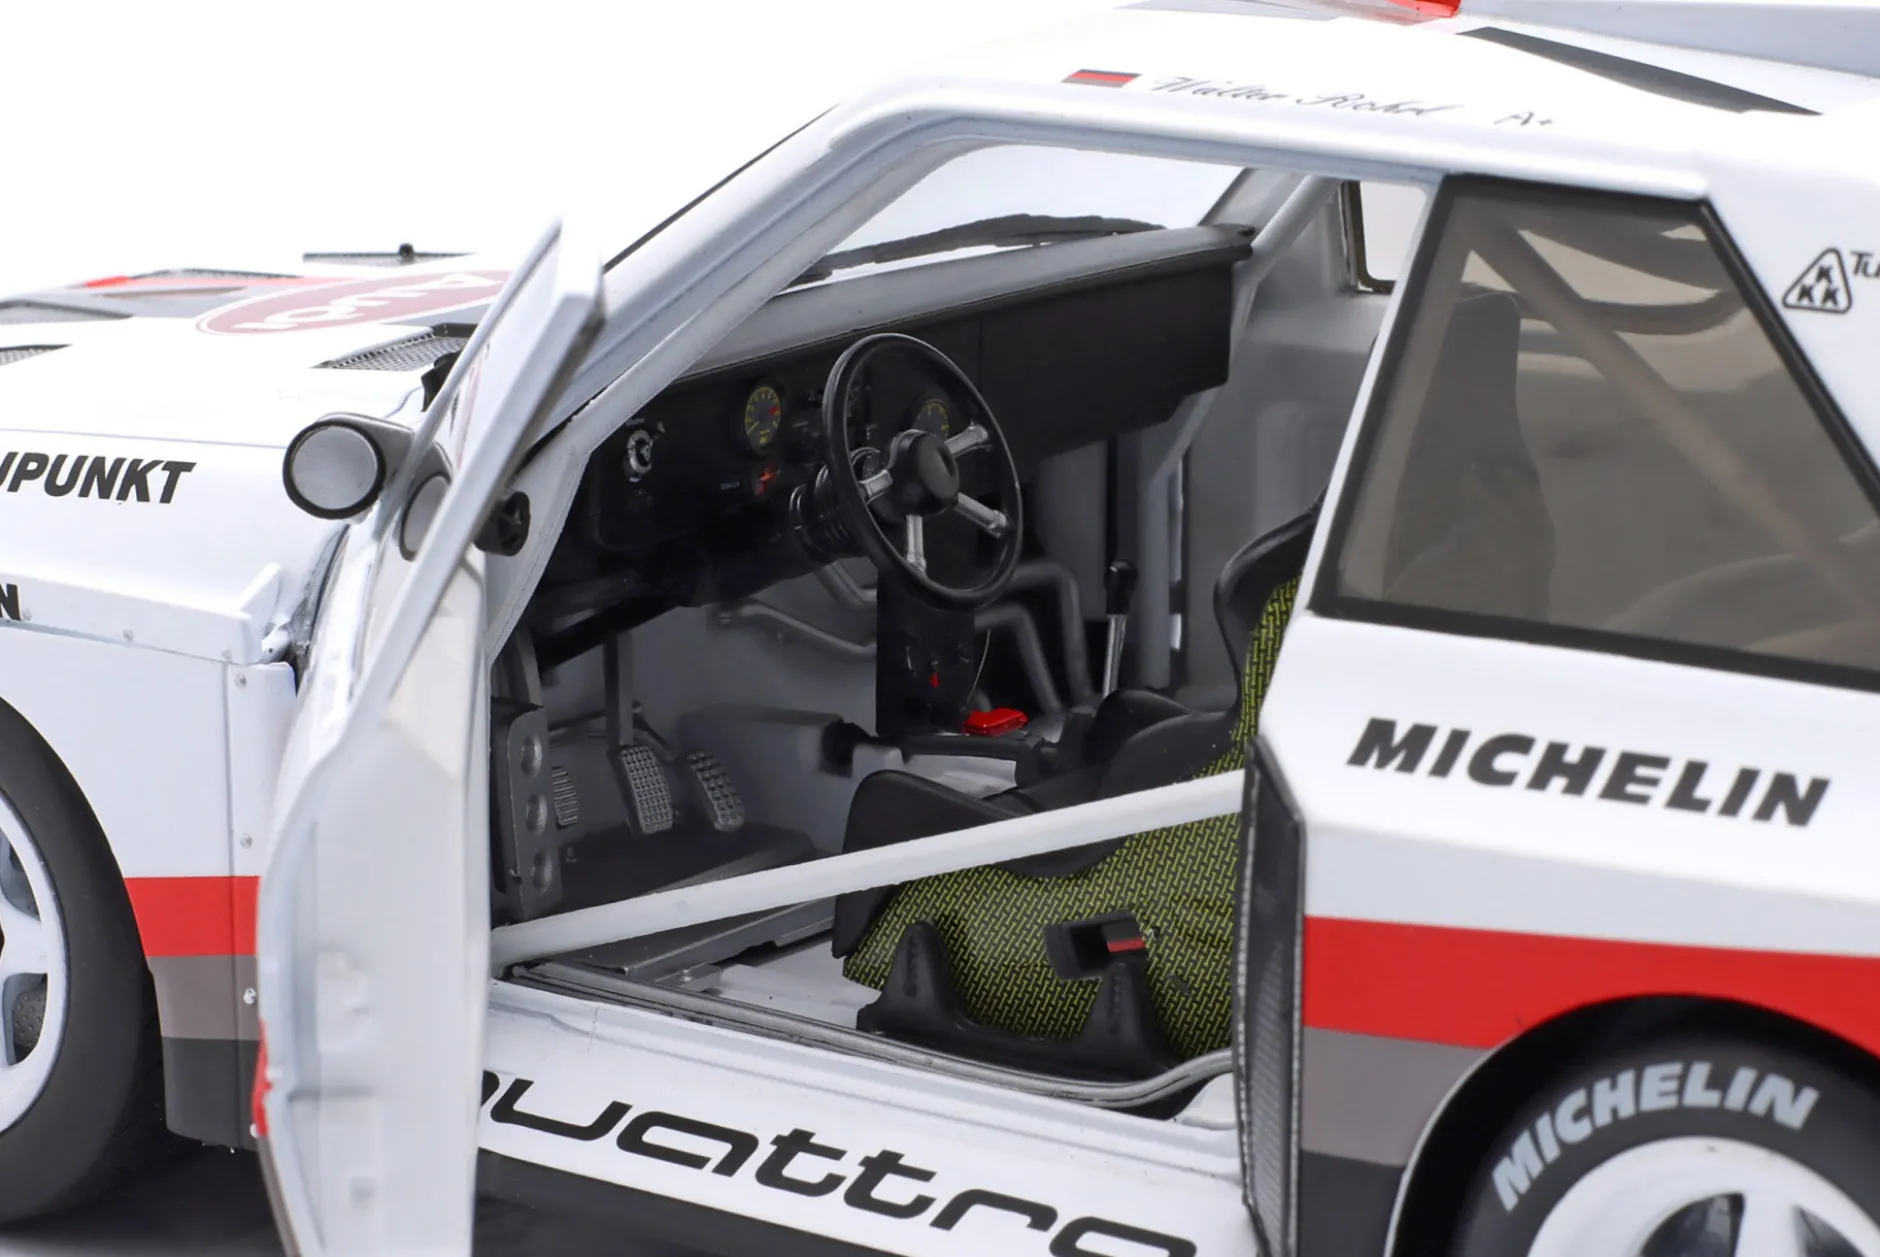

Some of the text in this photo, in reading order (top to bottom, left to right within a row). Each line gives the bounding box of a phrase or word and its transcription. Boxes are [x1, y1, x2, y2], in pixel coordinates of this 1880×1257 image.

[1347, 717, 1831, 827] MICHELIN
[479, 1069, 1198, 1257] uattro
[1492, 1060, 1820, 1212] MICHELIN
